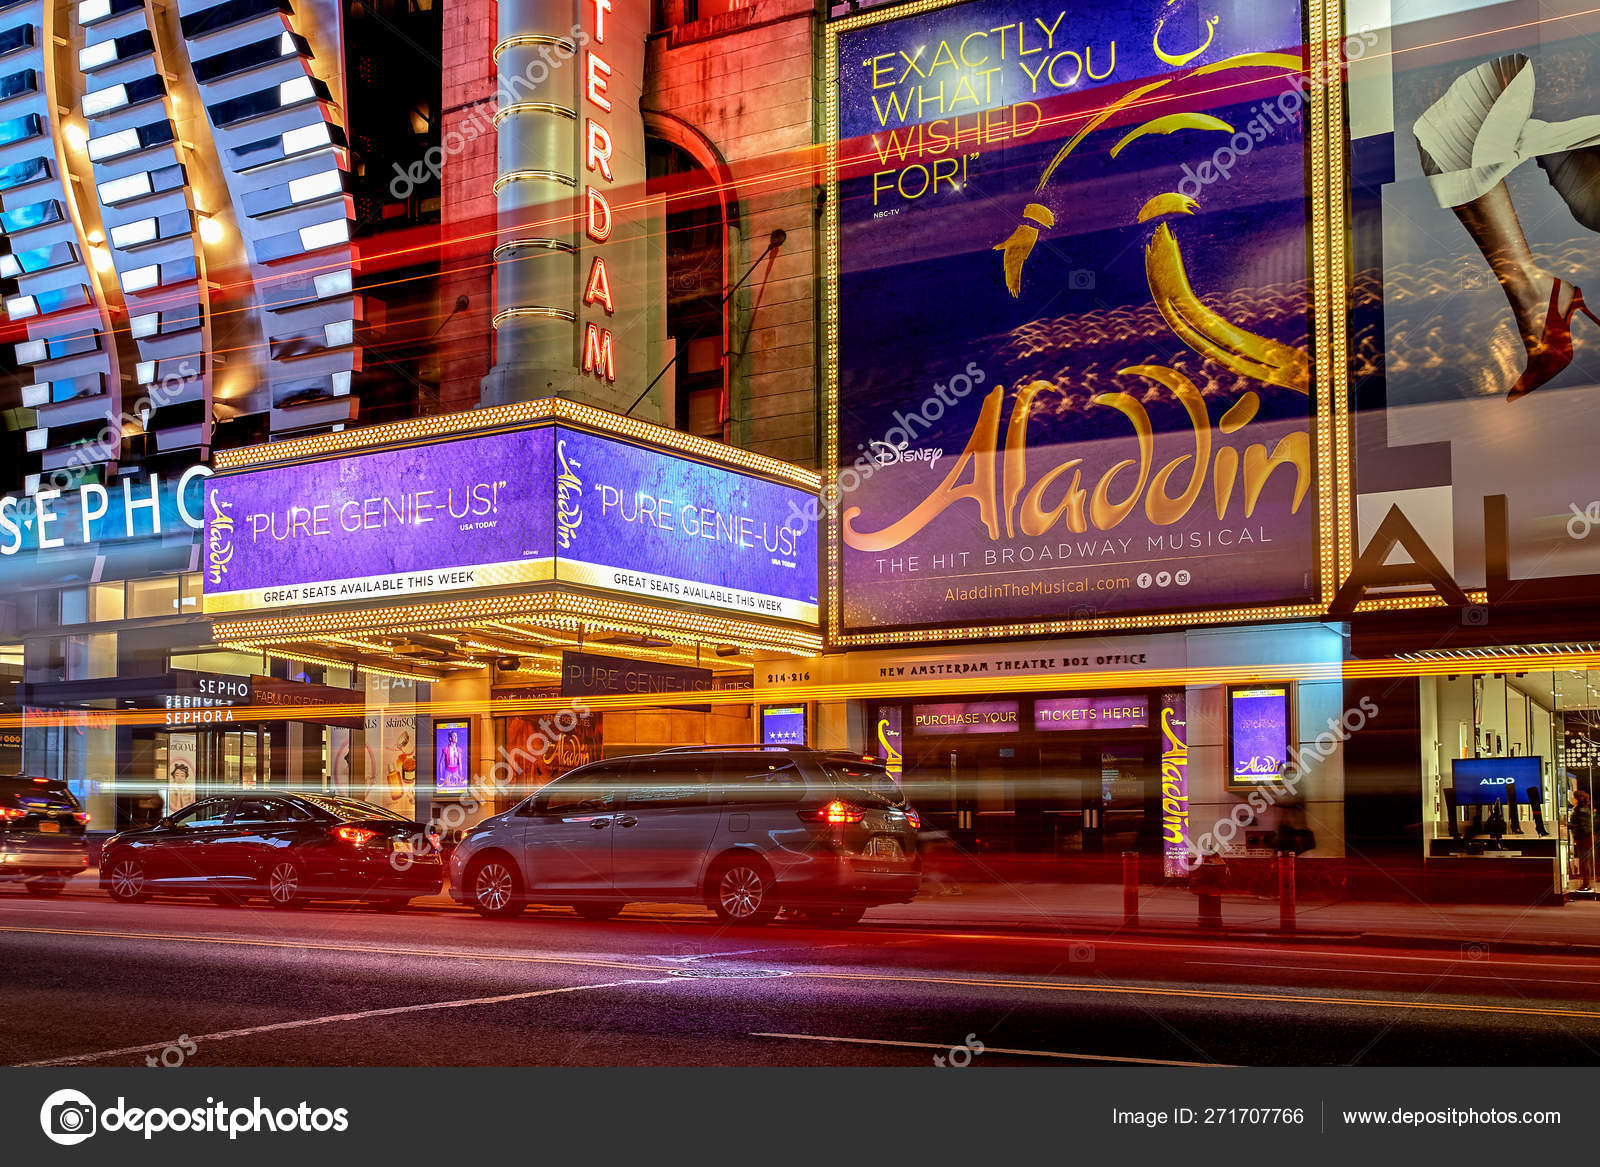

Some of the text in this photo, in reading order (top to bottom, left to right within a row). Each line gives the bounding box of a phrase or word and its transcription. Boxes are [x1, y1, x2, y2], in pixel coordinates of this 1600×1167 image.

[862, 11, 1066, 89] “EXACTLY
[872, 42, 1116, 126] WHAT YOU
[872, 101, 1042, 165] WISHED
[584, 0, 615, 382] TERDAM
[873, 152, 980, 205] FOR!”
[873, 209, 900, 218] NBC-TV
[843, 364, 1311, 552] Aladdin
[558, 439, 582, 549] Aladdin
[210, 488, 234, 584] Aladdin
[459, 520, 497, 531] USA TODAY
[876, 525, 1273, 574] THE HIT BROADWAY MUSICAL
[264, 571, 475, 603] GREAT SEATS AVAILABLE THIS WEEK
[614, 573, 782, 612] GREAT SEATS AVAILABLE THIS WEEK
[944, 573, 1130, 602] AladdinTheMusical.com
[880, 653, 1147, 677] NEW AMSTERDAM THEATRE BOX OFFICE
[199, 679, 248, 697] SEPHO
[166, 710, 233, 725] SEPHORA
[915, 711, 1017, 726] PURCHASE YOUR
[1039, 707, 1145, 721] TICKETS HERE!
[1161, 708, 1190, 844] Aladdin
[1479, 777, 1515, 786] ALDO
